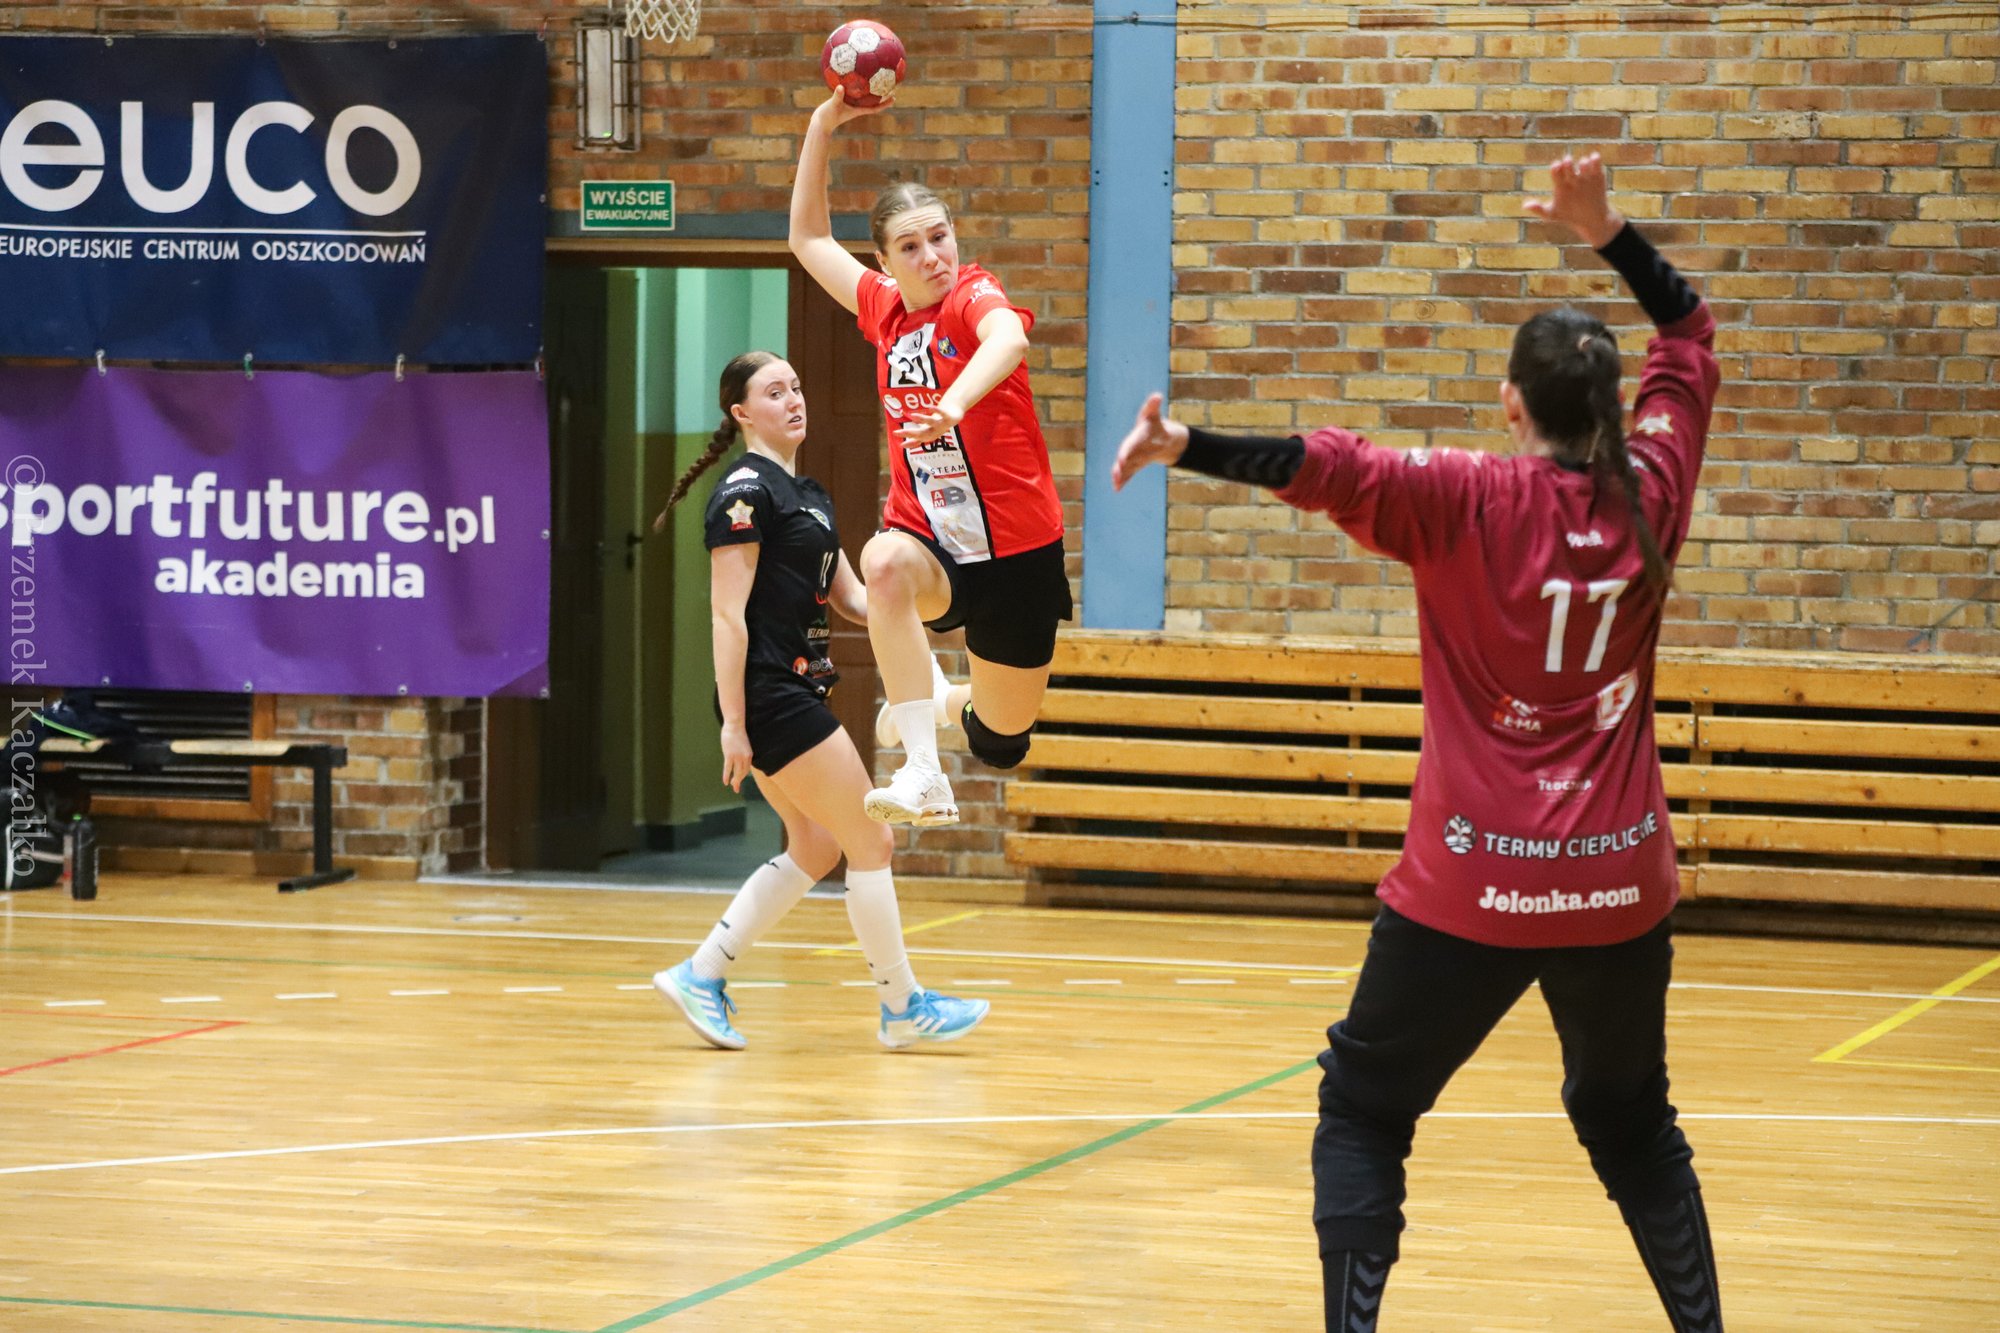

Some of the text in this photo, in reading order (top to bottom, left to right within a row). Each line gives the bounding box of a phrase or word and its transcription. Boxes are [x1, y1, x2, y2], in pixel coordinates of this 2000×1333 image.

[0, 100, 421, 216] euco
[590, 187, 666, 206] WYJŚCIE
[586, 209, 670, 221] EWAKUACYJNE
[0, 235, 426, 263] EUROPEJSKIE CENTRUM ODSZKODOWAŃ
[898, 355, 928, 386] 21
[904, 392, 942, 409] euc
[931, 464, 966, 476] STEAM
[0, 472, 496, 553] portfuture.pl
[155, 549, 425, 598] akademia
[1540, 578, 1629, 673] 17
[1484, 811, 1659, 859] TERMY CIEPLICIE
[1478, 885, 1641, 914] Jelonka.com
